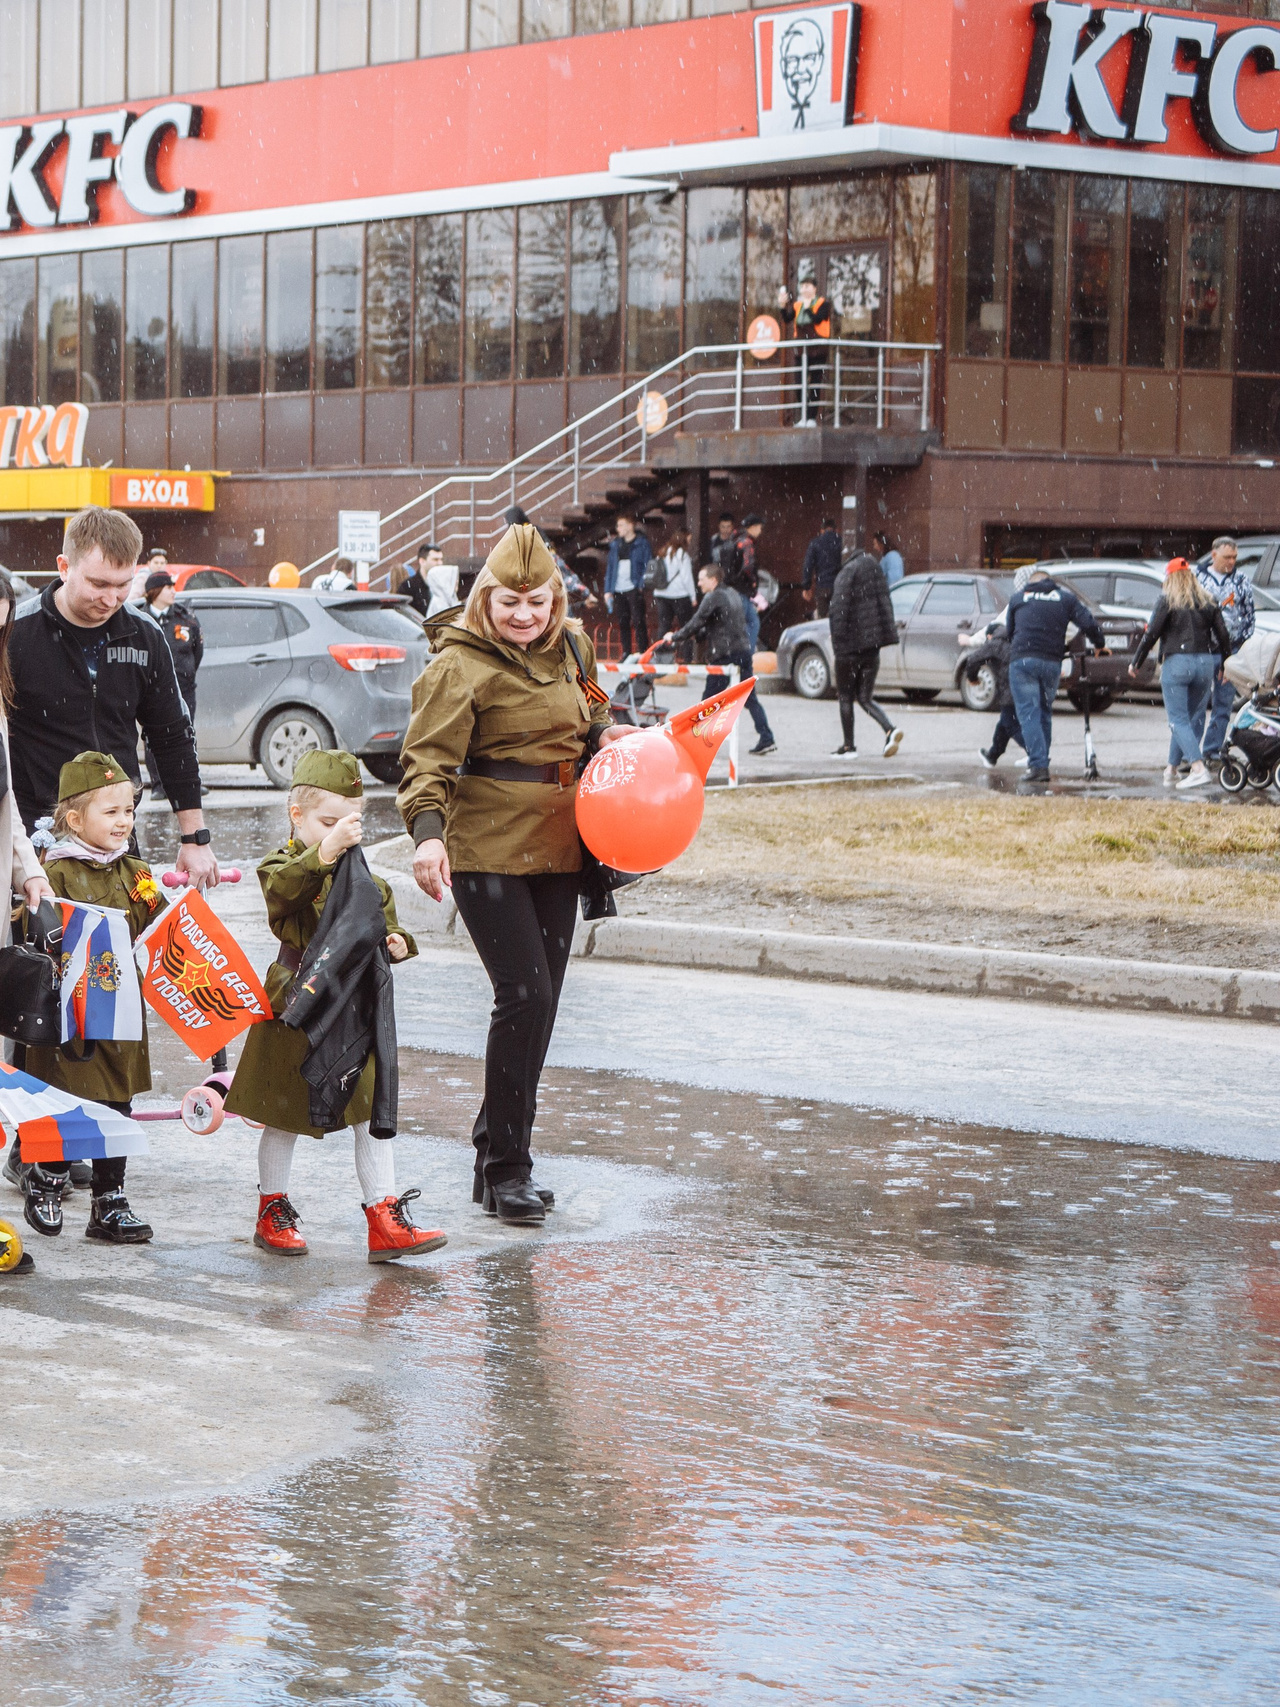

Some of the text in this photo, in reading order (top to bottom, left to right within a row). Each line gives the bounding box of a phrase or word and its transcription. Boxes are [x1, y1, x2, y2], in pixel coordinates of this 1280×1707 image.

[1014, 0, 1280, 155] KFC
[127, 479, 189, 507] ВХОД
[1023, 590, 1061, 602] FILA
[107, 646, 149, 667] PUMA
[178, 902, 266, 1016] СПАСИБО ДЕДУ
[150, 945, 212, 1030] ЗА ПОБЕДУ
